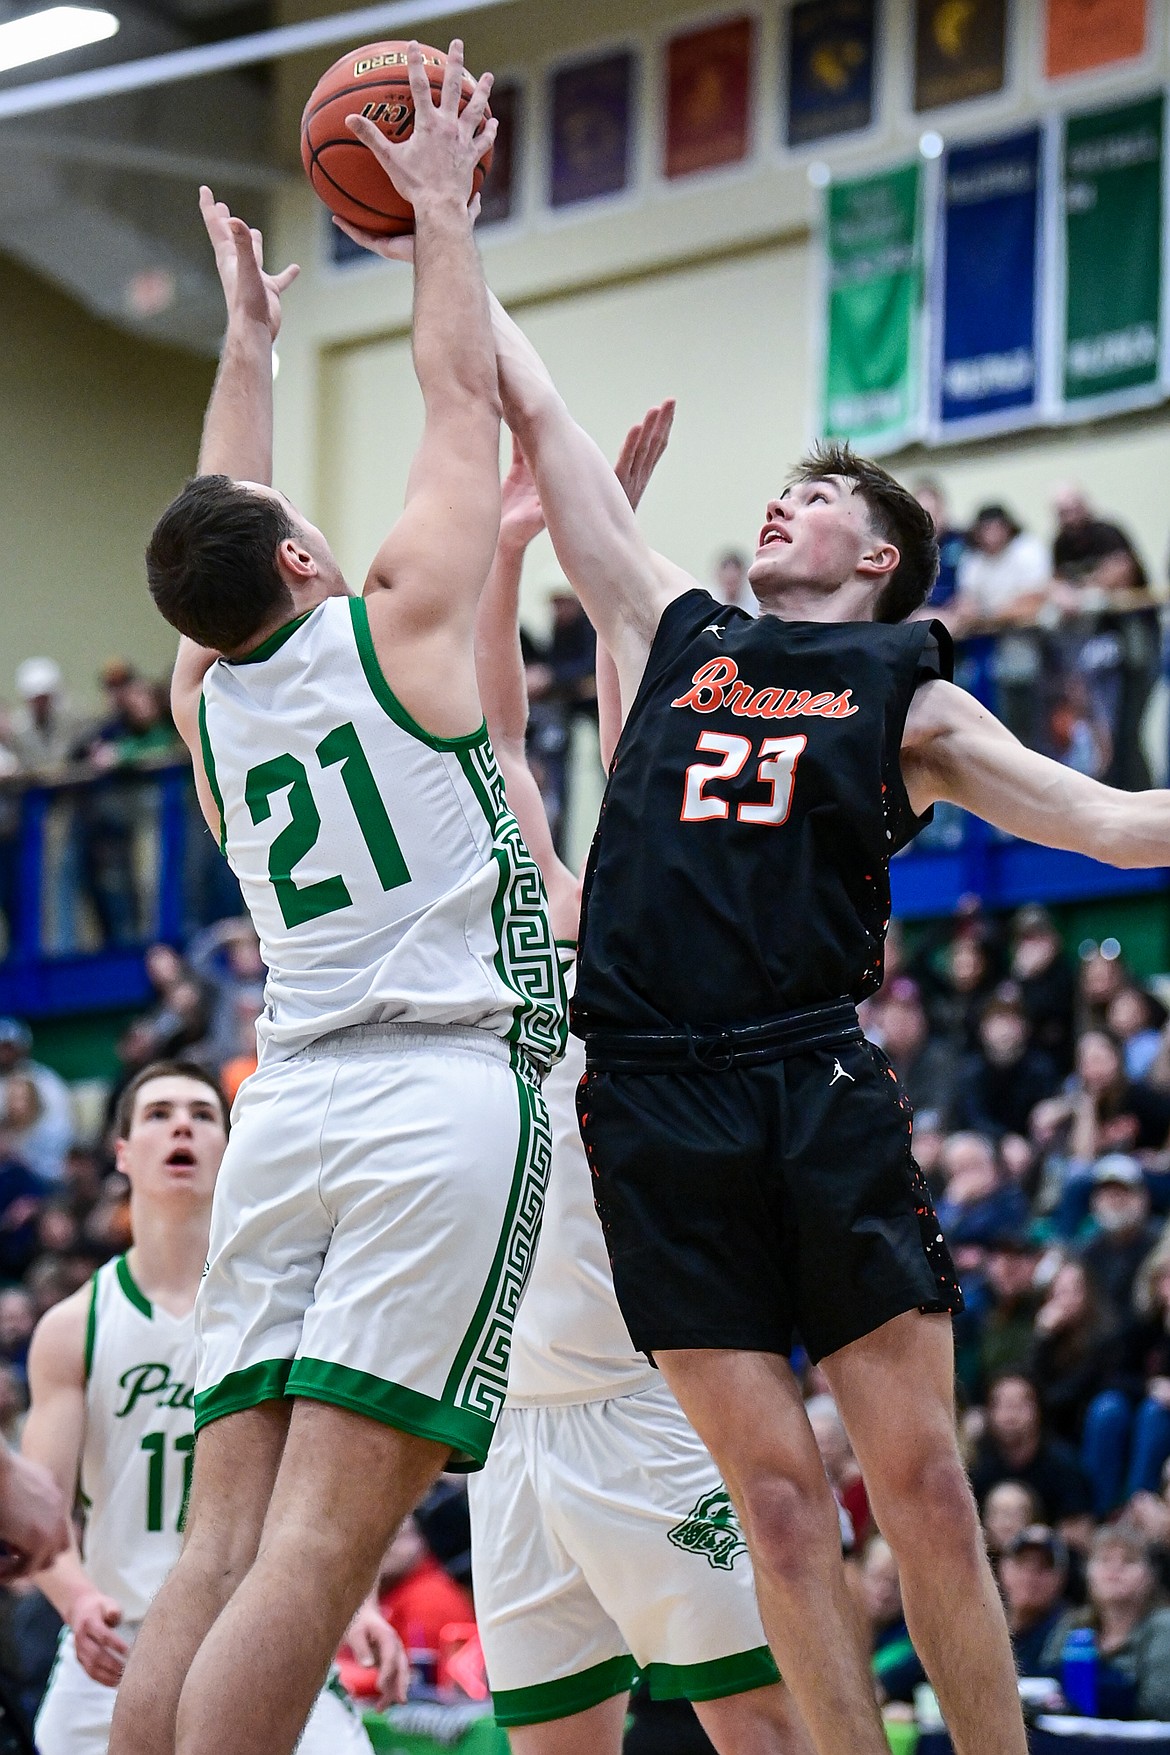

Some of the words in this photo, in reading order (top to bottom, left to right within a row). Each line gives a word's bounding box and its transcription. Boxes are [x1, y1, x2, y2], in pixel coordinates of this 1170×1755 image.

[670, 656, 860, 719] Braves
[245, 721, 413, 930] 21
[679, 730, 808, 826] 23
